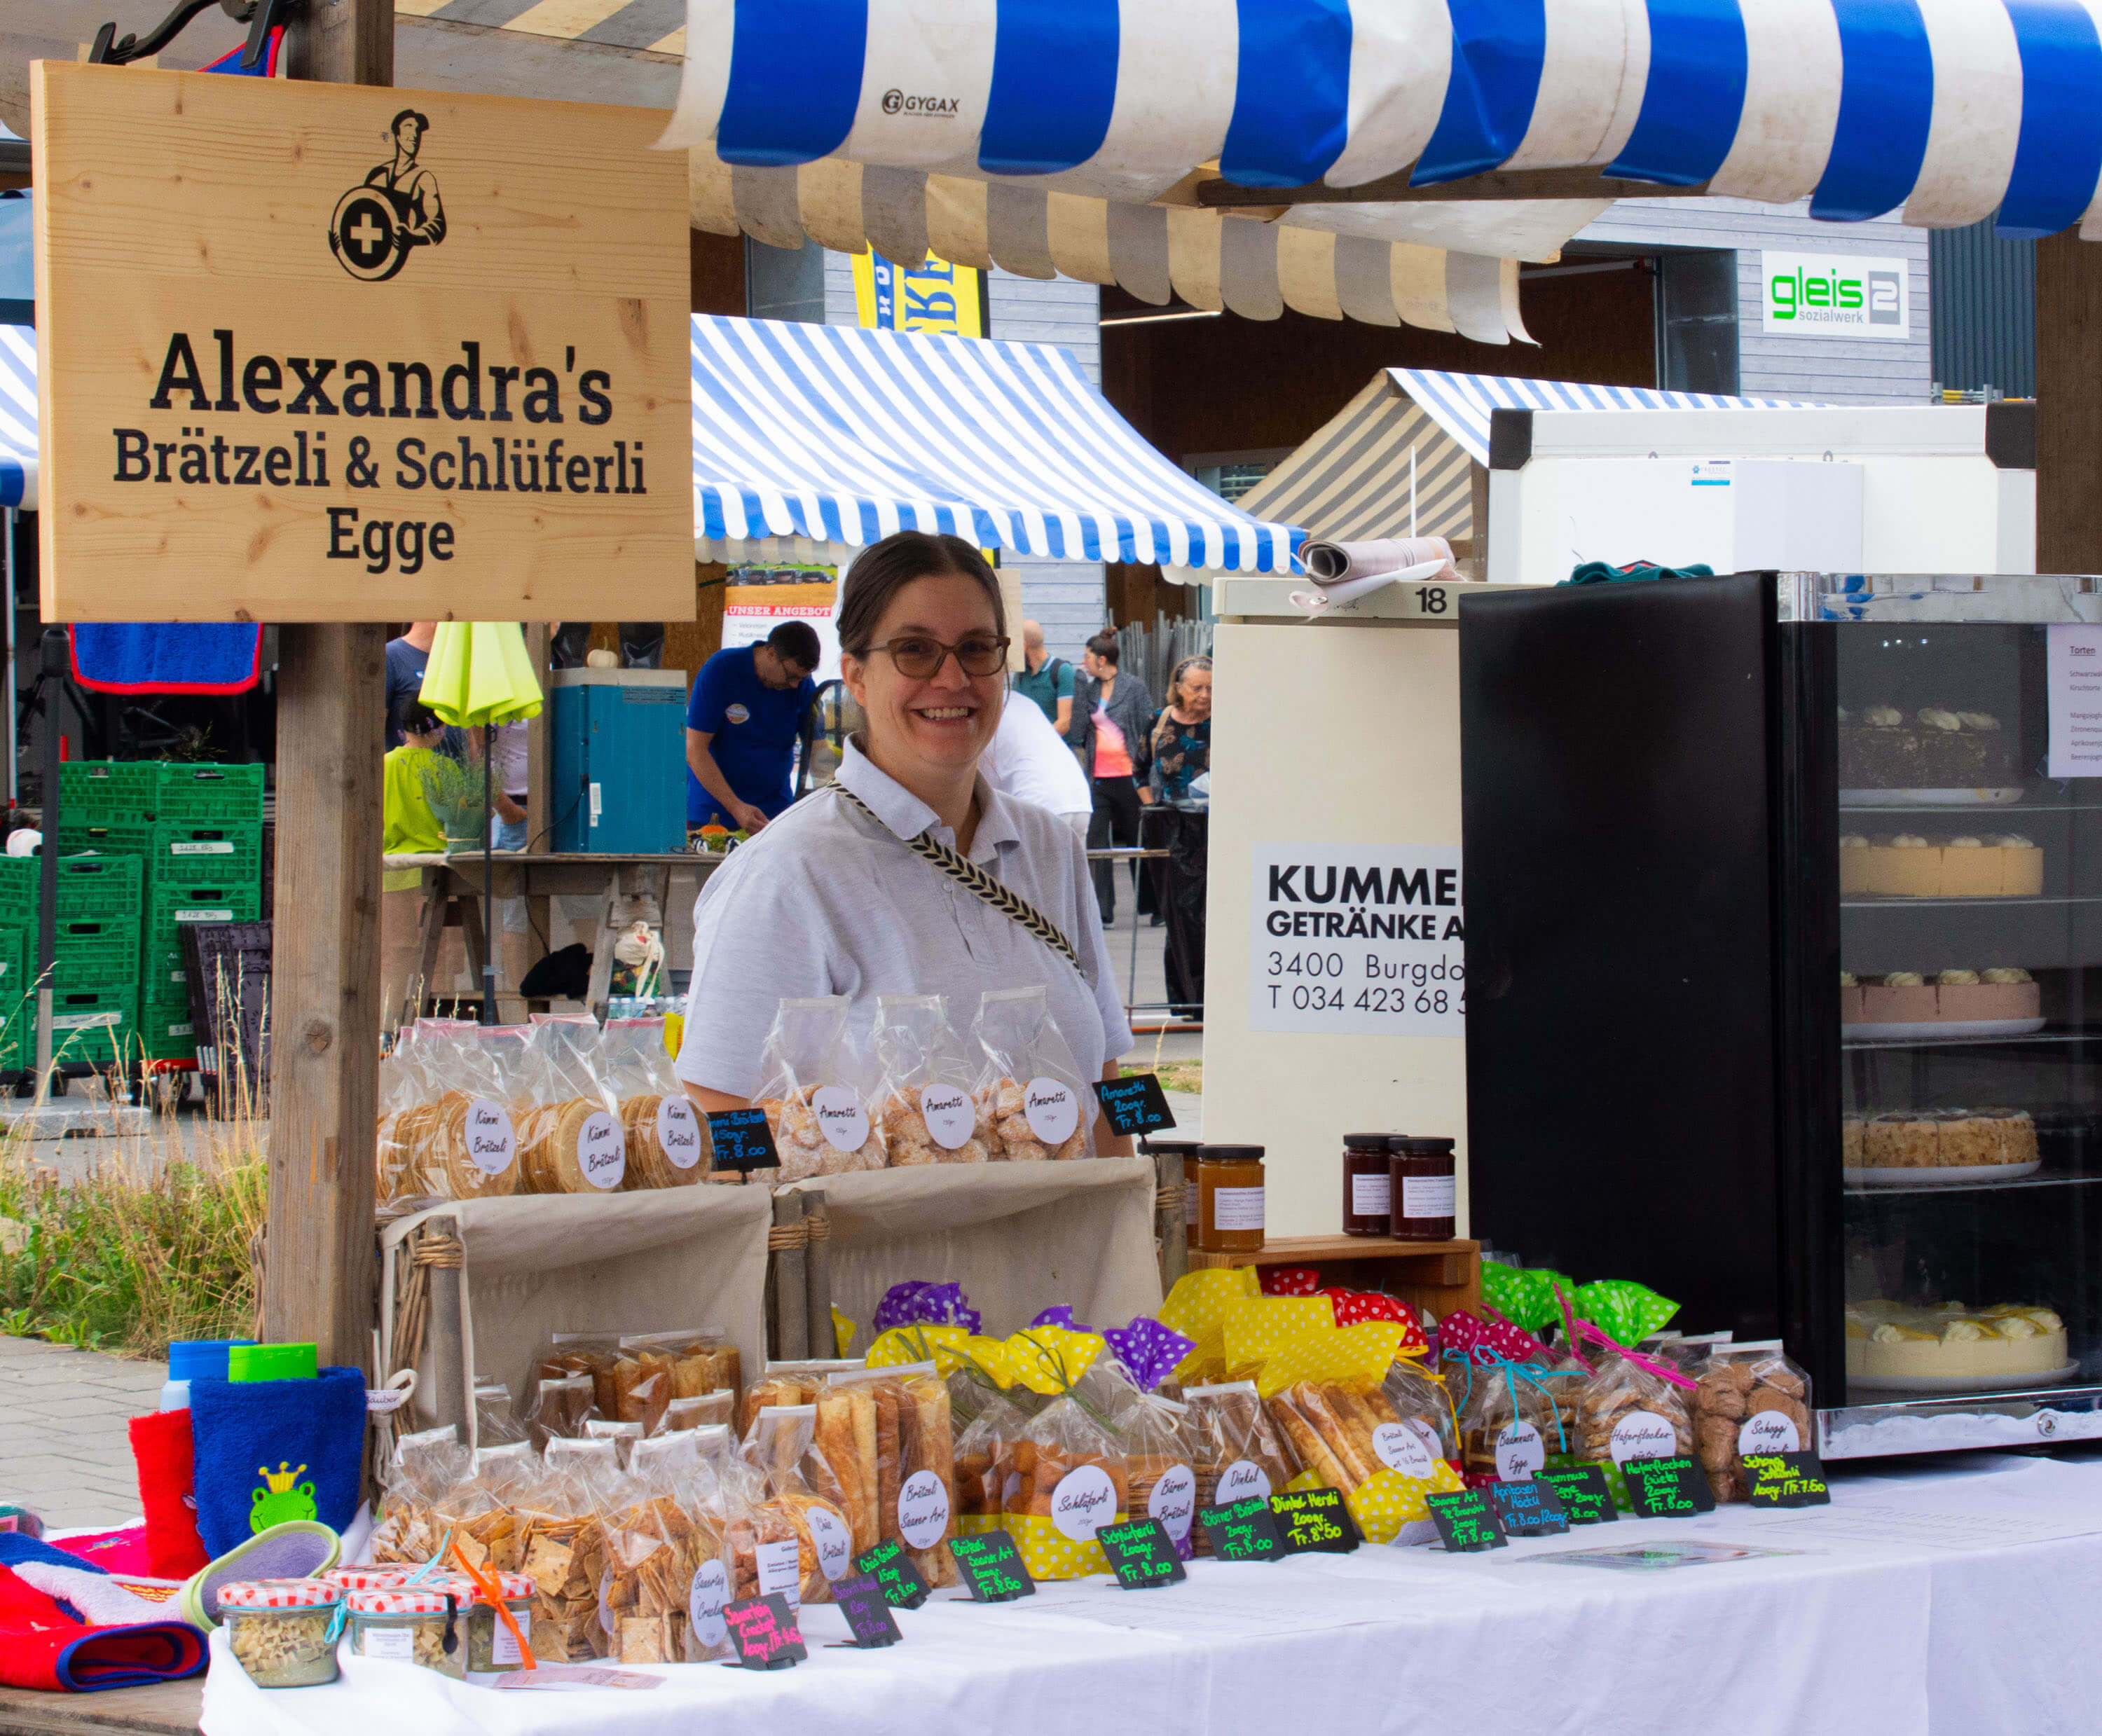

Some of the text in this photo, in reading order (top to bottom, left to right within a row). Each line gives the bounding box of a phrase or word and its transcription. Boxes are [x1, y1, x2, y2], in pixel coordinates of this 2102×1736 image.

[905, 96, 960, 113] GYGAX
[1771, 266, 1898, 320] gleis 2
[1799, 309, 1864, 324] sozialwerk
[149, 329, 614, 426] Alexandra's
[113, 427, 647, 495] Brätzeli & Schlüferli
[326, 507, 455, 574] Egge
[728, 605, 830, 616] UNSER ANGEBOT
[1415, 586, 1447, 614] 18
[2070, 645, 2096, 656] Torten
[1266, 907, 1436, 941] GETRÄNKE
[1268, 951, 1464, 988] 3400 Burgdo
[1268, 985, 1282, 1009] T
[1293, 985, 1345, 1011] 034
[1353, 986, 1405, 1013] 423
[1415, 989, 1448, 1014] 68
[820, 1104, 856, 1118] Amaretti
[926, 1096, 962, 1112] Amaretti
[1029, 1091, 1066, 1108] Amaretti
[1231, 1467, 1259, 1487] Dinkel
[1059, 1487, 1109, 1513] Schlüferli
